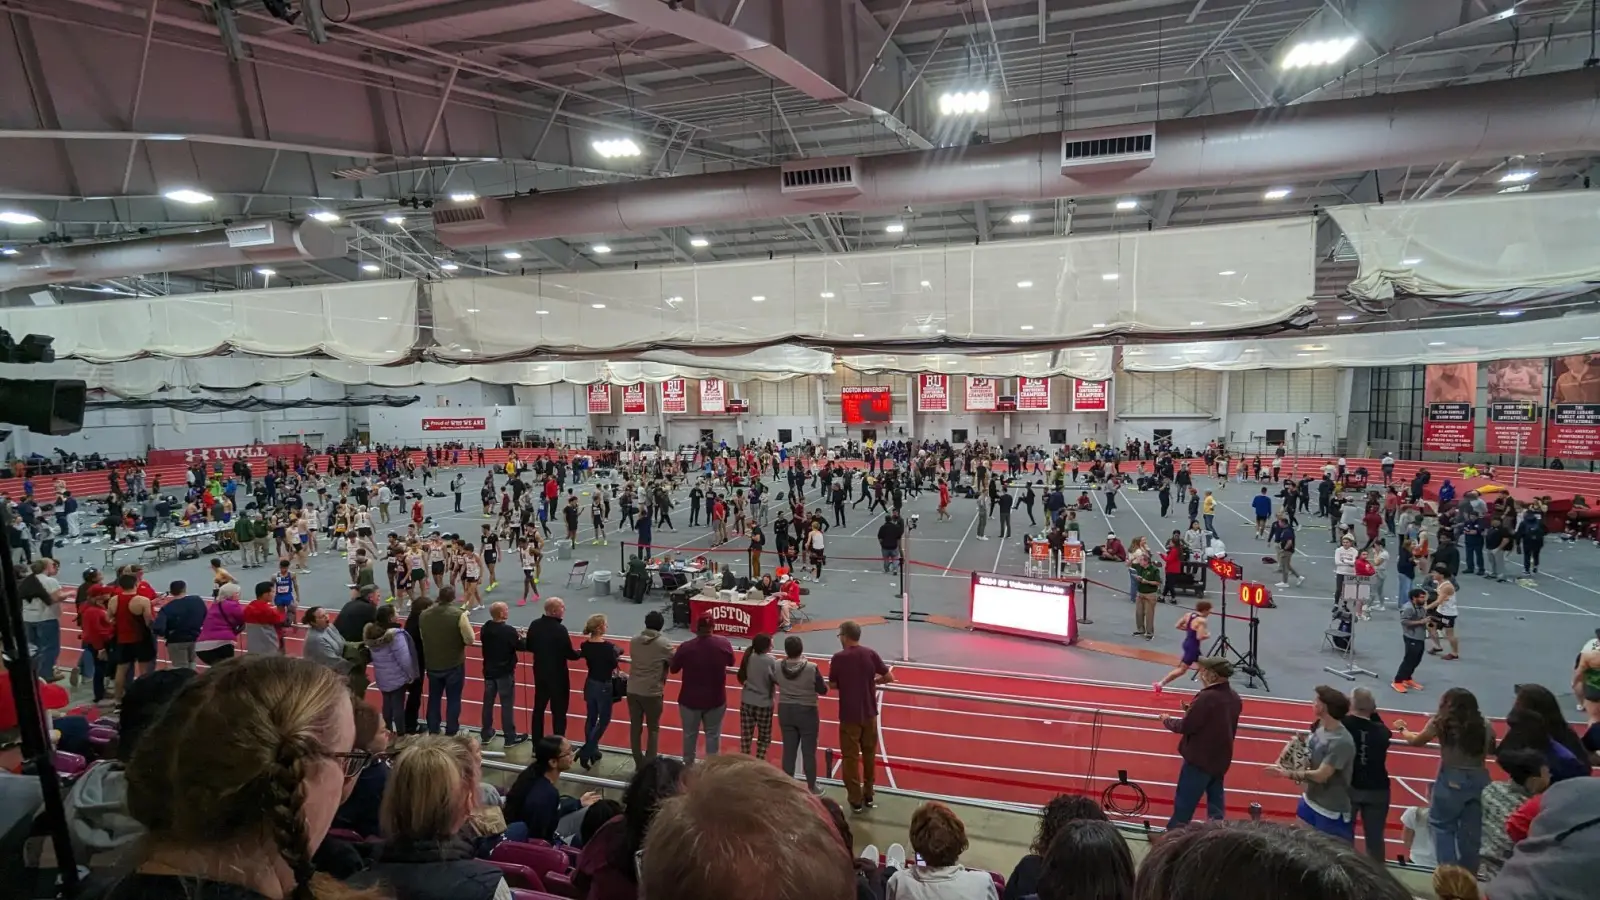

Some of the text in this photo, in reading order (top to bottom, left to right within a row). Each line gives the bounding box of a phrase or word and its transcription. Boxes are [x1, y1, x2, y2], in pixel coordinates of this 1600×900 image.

[668, 380, 680, 391] BU
[706, 380, 719, 391] BU
[926, 375, 942, 386] BU
[214, 449, 222, 459] I
[714, 624, 748, 634] NIVERSITY
